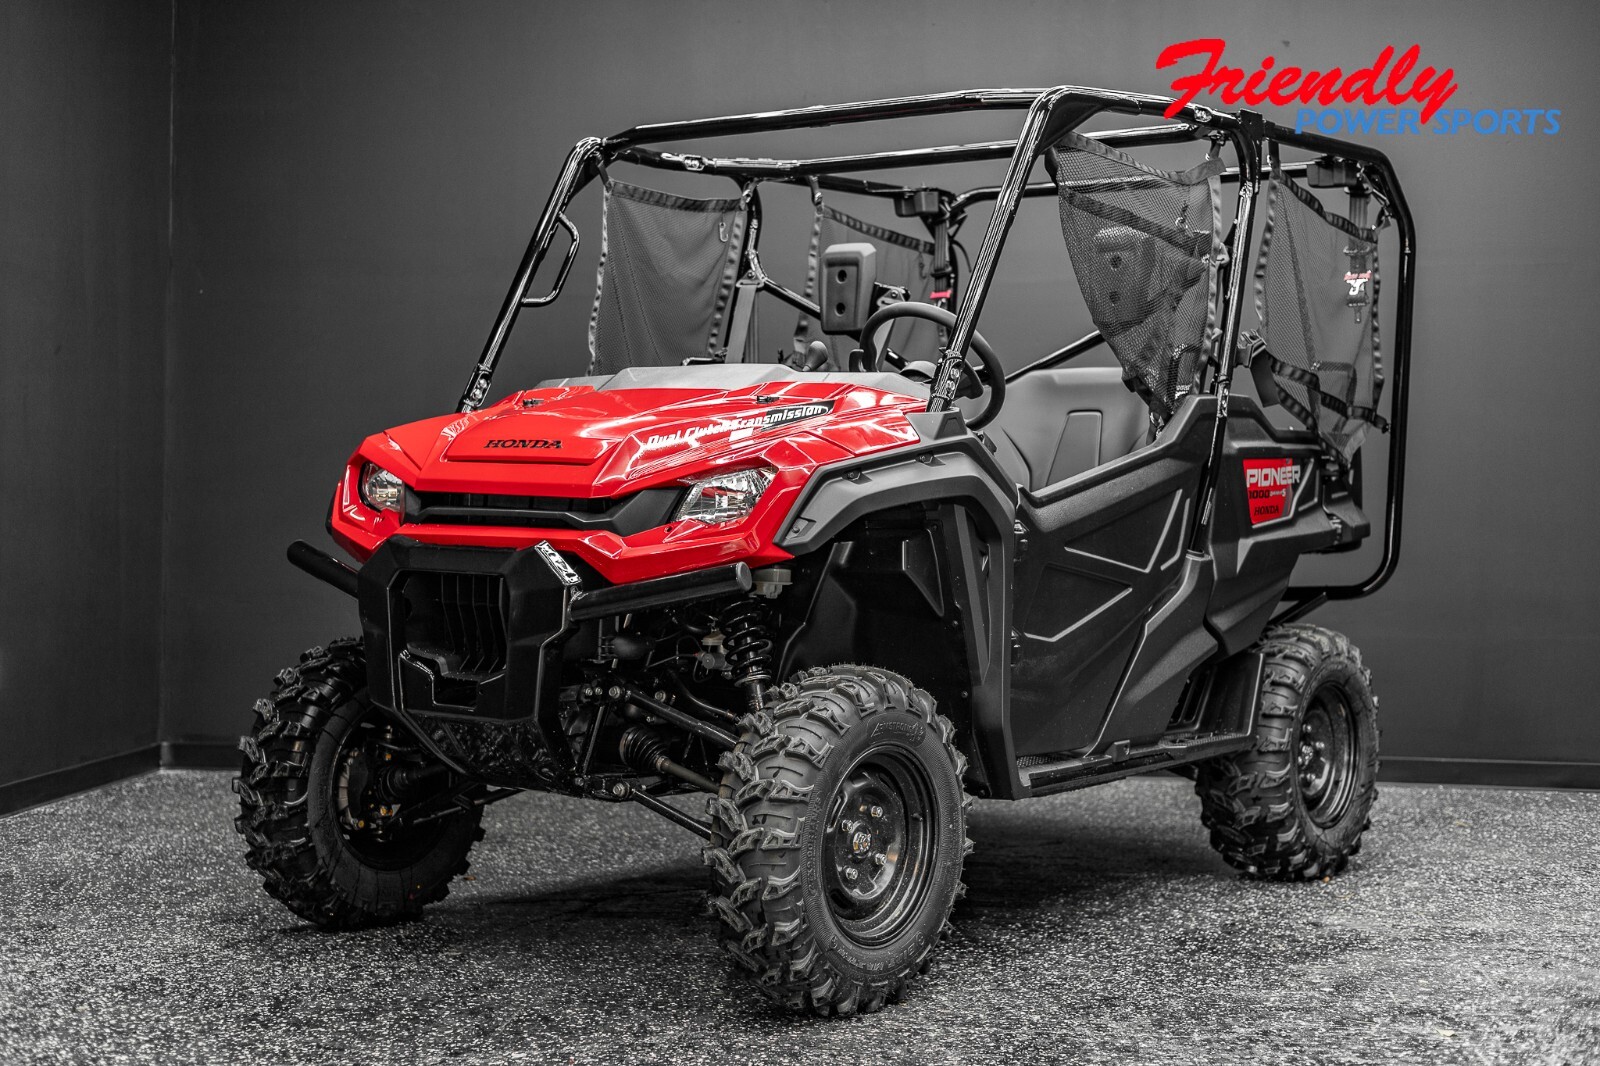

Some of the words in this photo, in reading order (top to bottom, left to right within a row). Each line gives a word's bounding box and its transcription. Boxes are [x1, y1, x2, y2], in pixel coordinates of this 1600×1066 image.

[647, 432, 680, 447] Dual
[736, 406, 823, 427] Transmission
[483, 439, 562, 449] HONDA
[1246, 465, 1301, 488] PIONEER
[1248, 489, 1270, 499] 1000
[1253, 505, 1280, 516] HONDA
